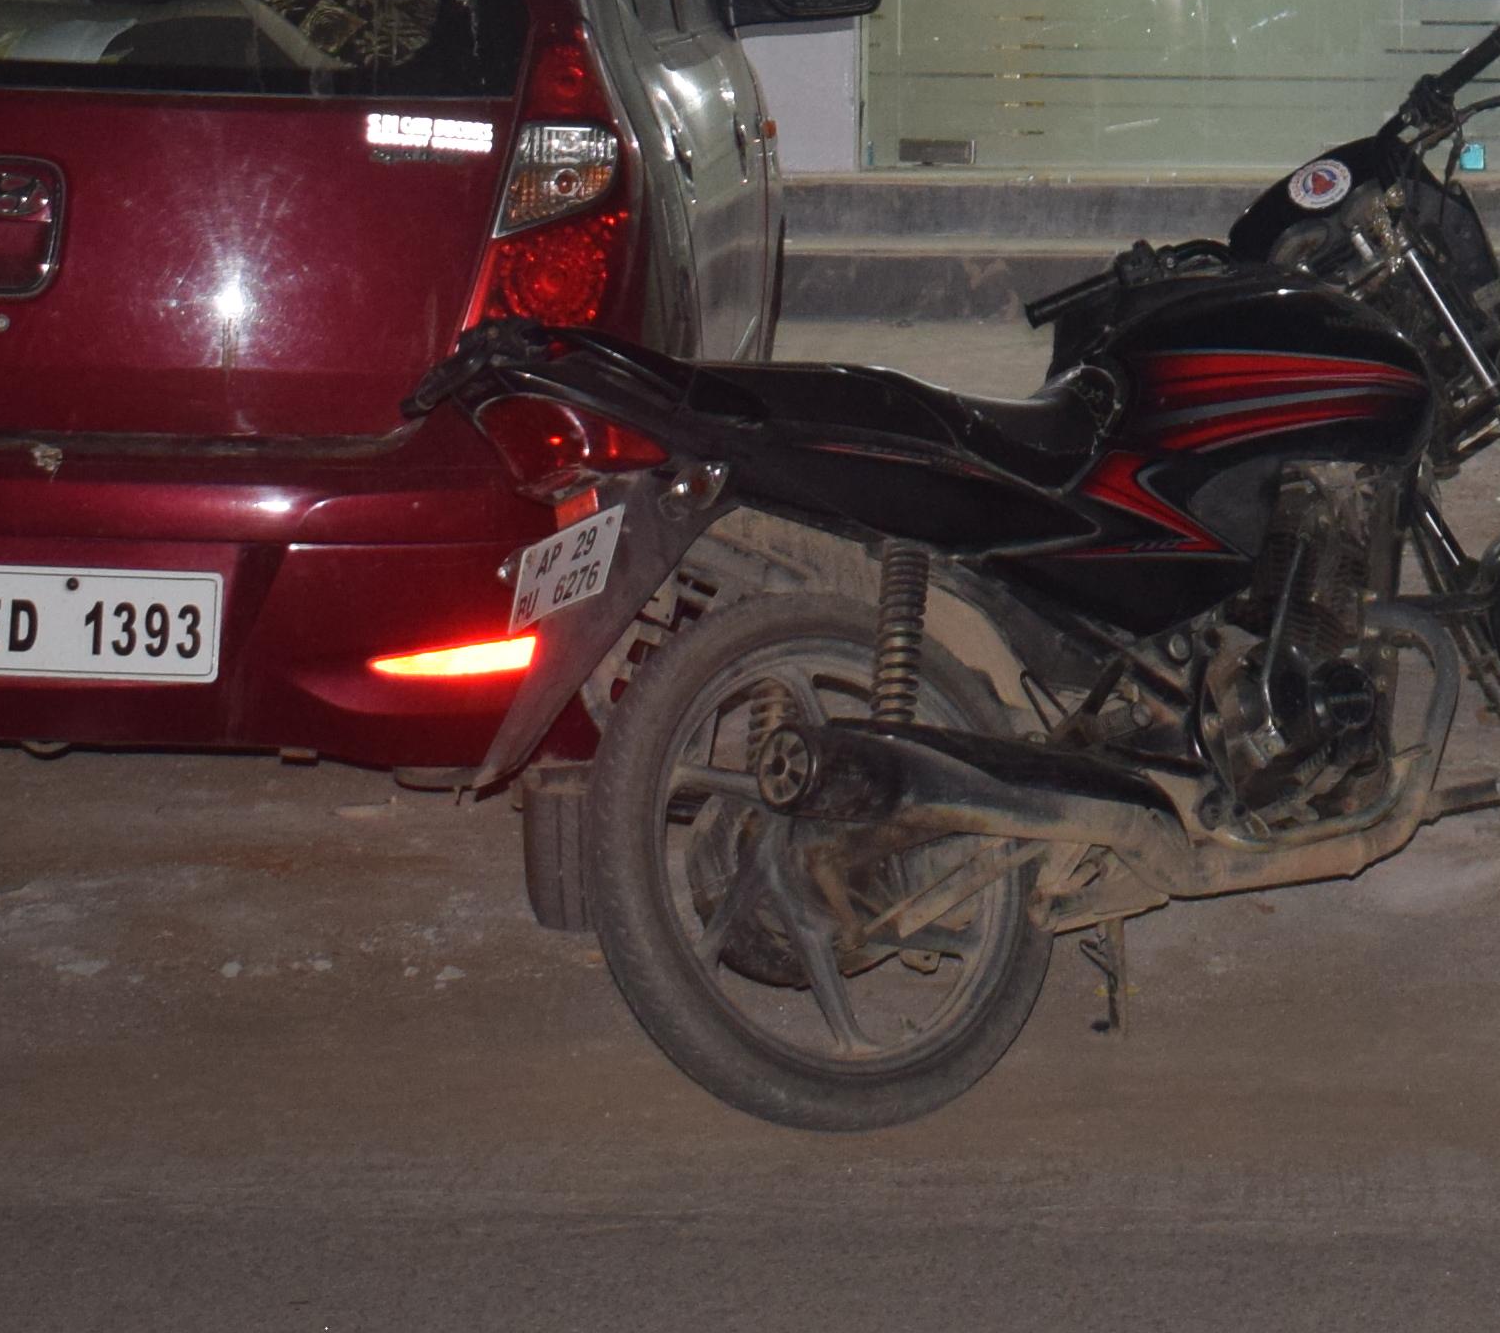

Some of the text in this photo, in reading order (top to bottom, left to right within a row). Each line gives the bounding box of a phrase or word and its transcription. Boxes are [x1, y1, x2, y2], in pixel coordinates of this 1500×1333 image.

[535, 526, 598, 580] AP 29
[553, 561, 601, 604] 6276
[84, 600, 202, 659] 1393
